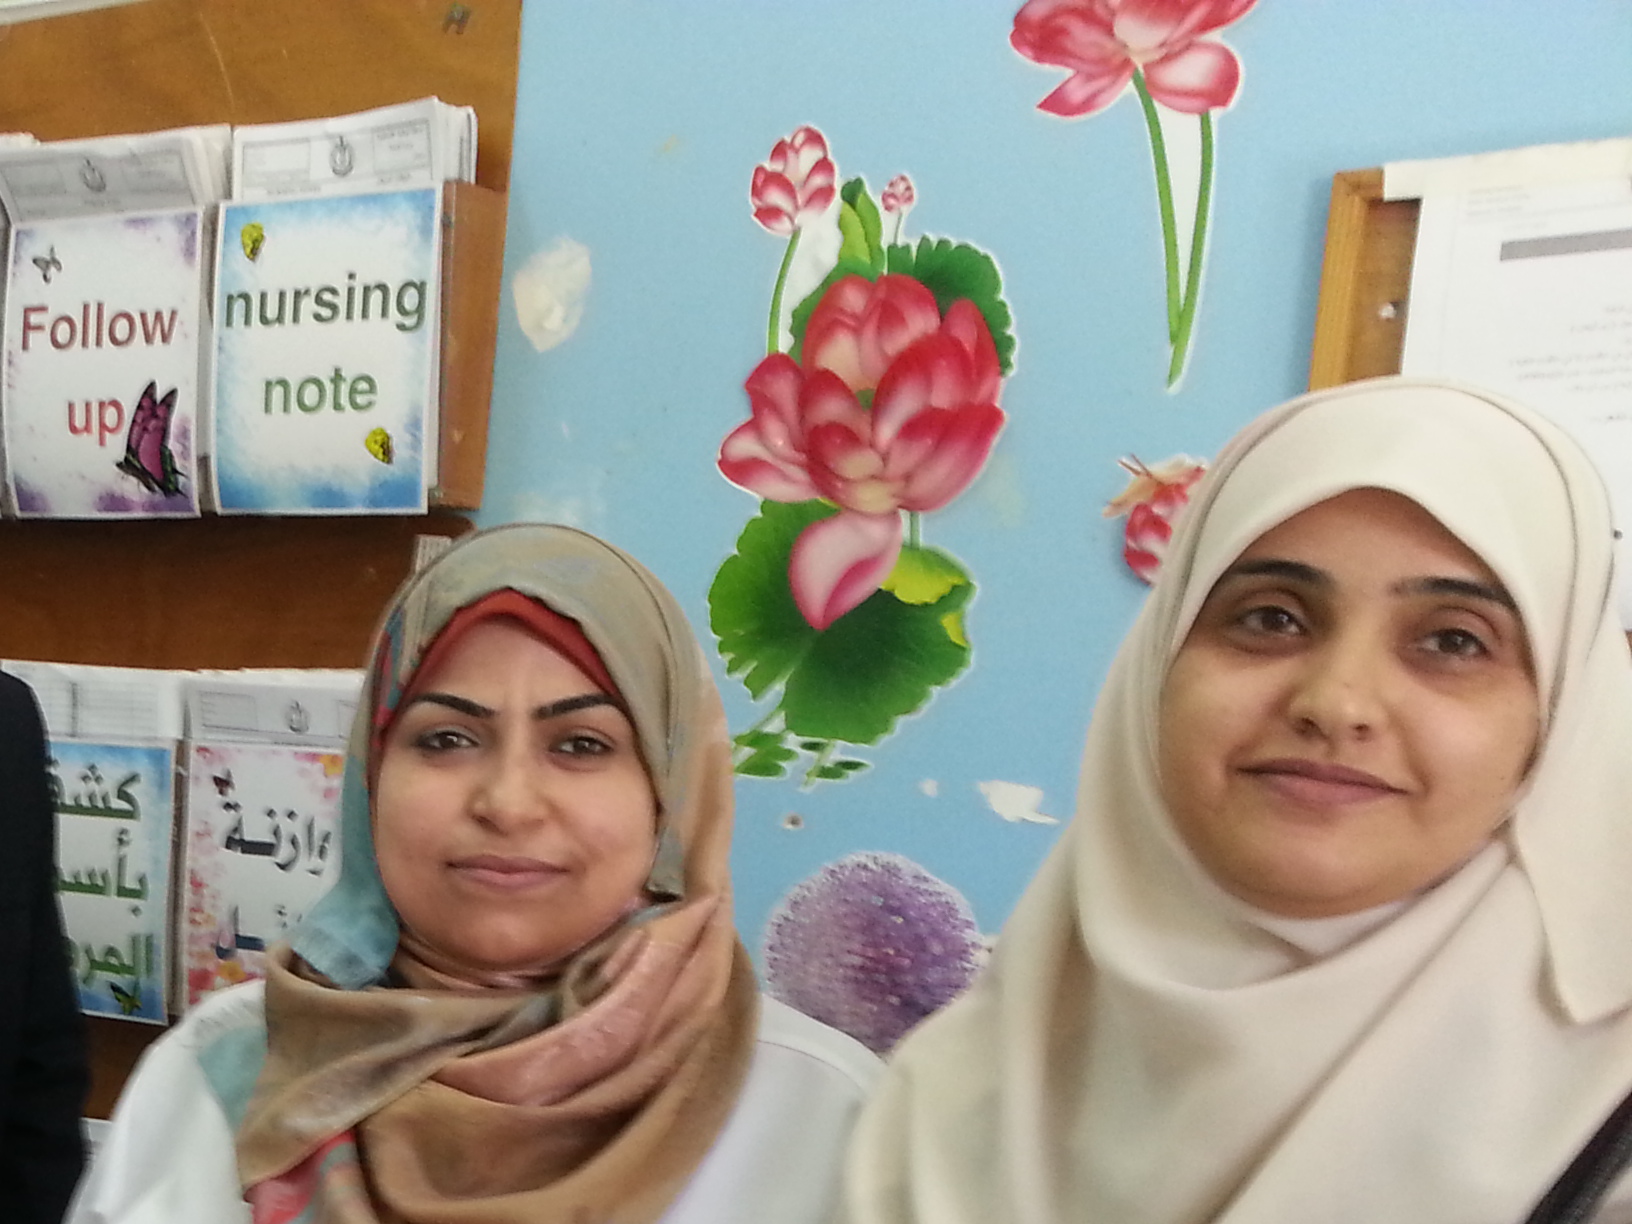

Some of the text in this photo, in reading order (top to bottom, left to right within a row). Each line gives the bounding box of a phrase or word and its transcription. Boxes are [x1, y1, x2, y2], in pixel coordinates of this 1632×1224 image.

[225, 271, 427, 332] nursing
[21, 302, 179, 352] Follow
[264, 366, 378, 415] note
[68, 399, 125, 447] up
[223, 801, 333, 877] وازنة
